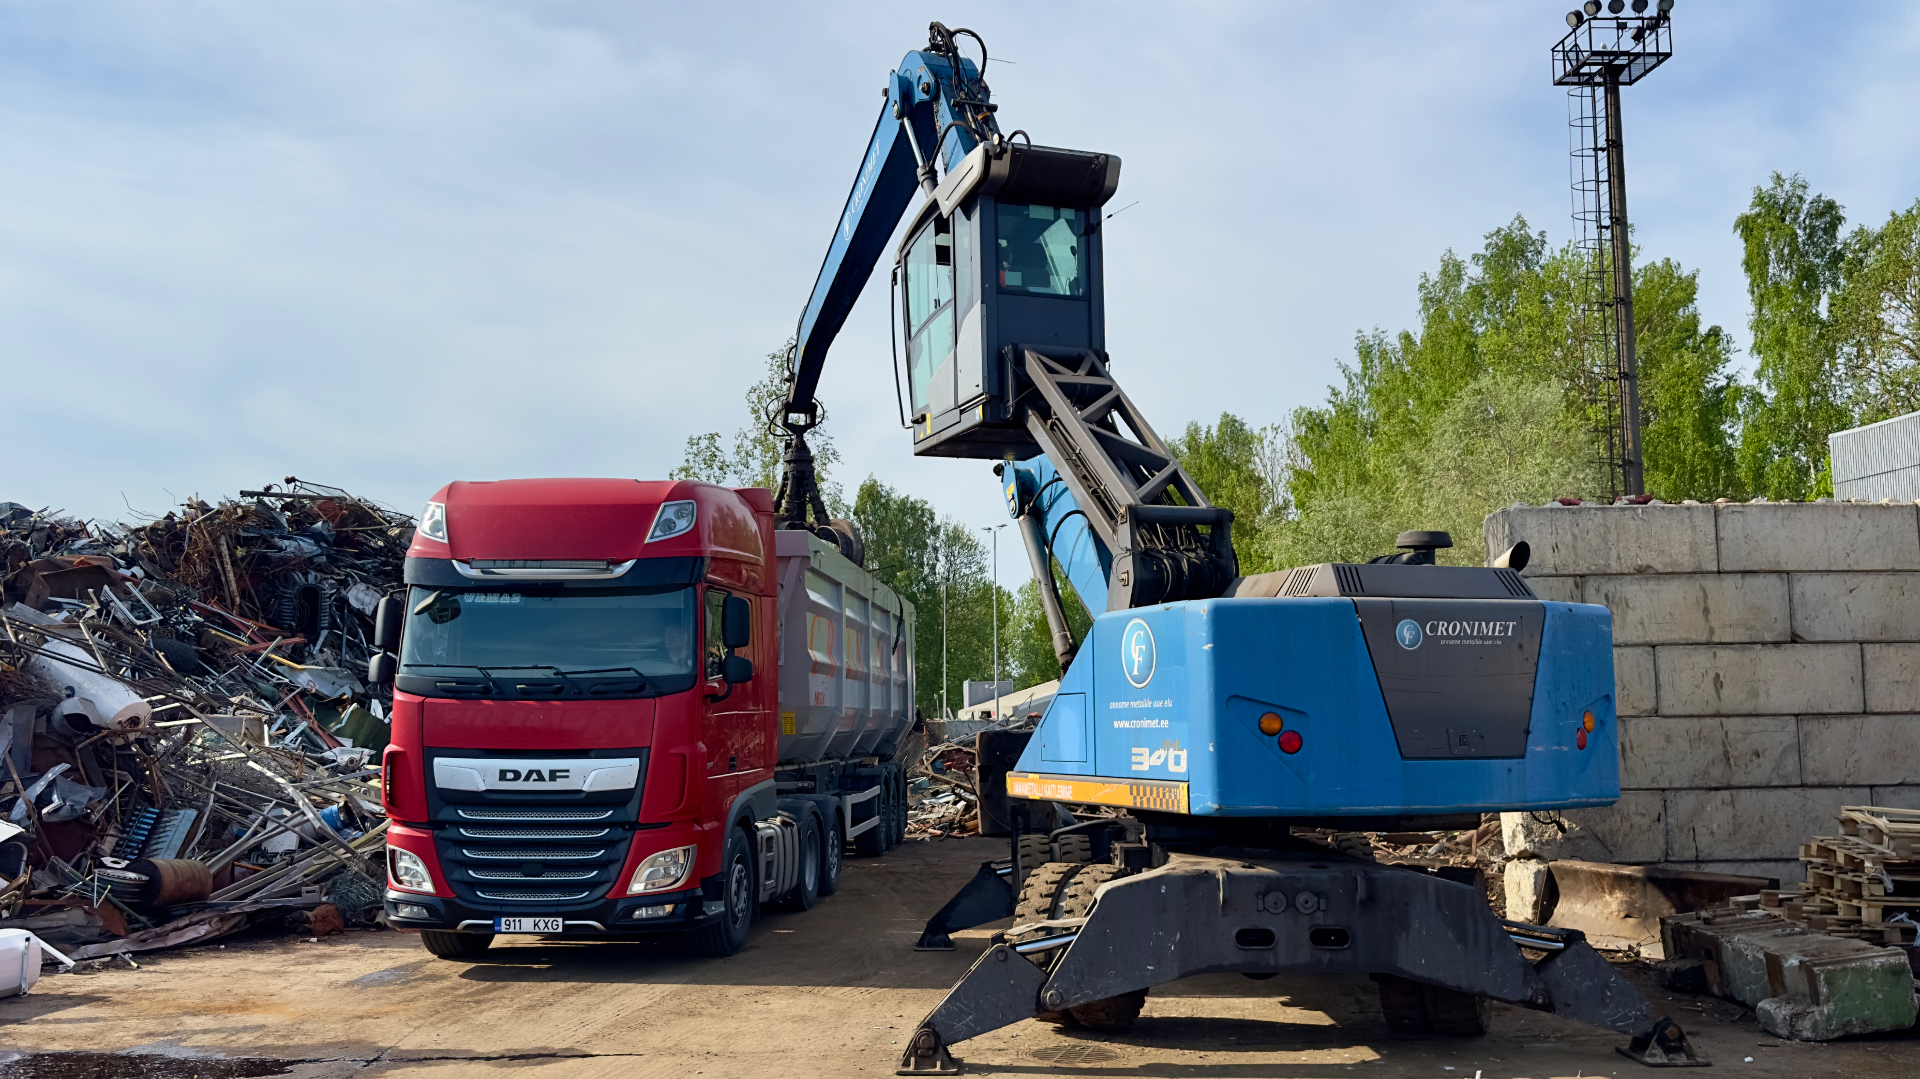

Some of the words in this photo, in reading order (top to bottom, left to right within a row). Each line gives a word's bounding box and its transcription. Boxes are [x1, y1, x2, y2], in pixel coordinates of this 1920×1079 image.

[1425, 620, 1517, 637] CRONIMET
[1113, 717, 1169, 729] www.cronimet.ee
[1131, 747, 1188, 773] 340
[498, 769, 570, 782] DAF
[504, 919, 522, 931] 911
[533, 919, 560, 931] KXG
